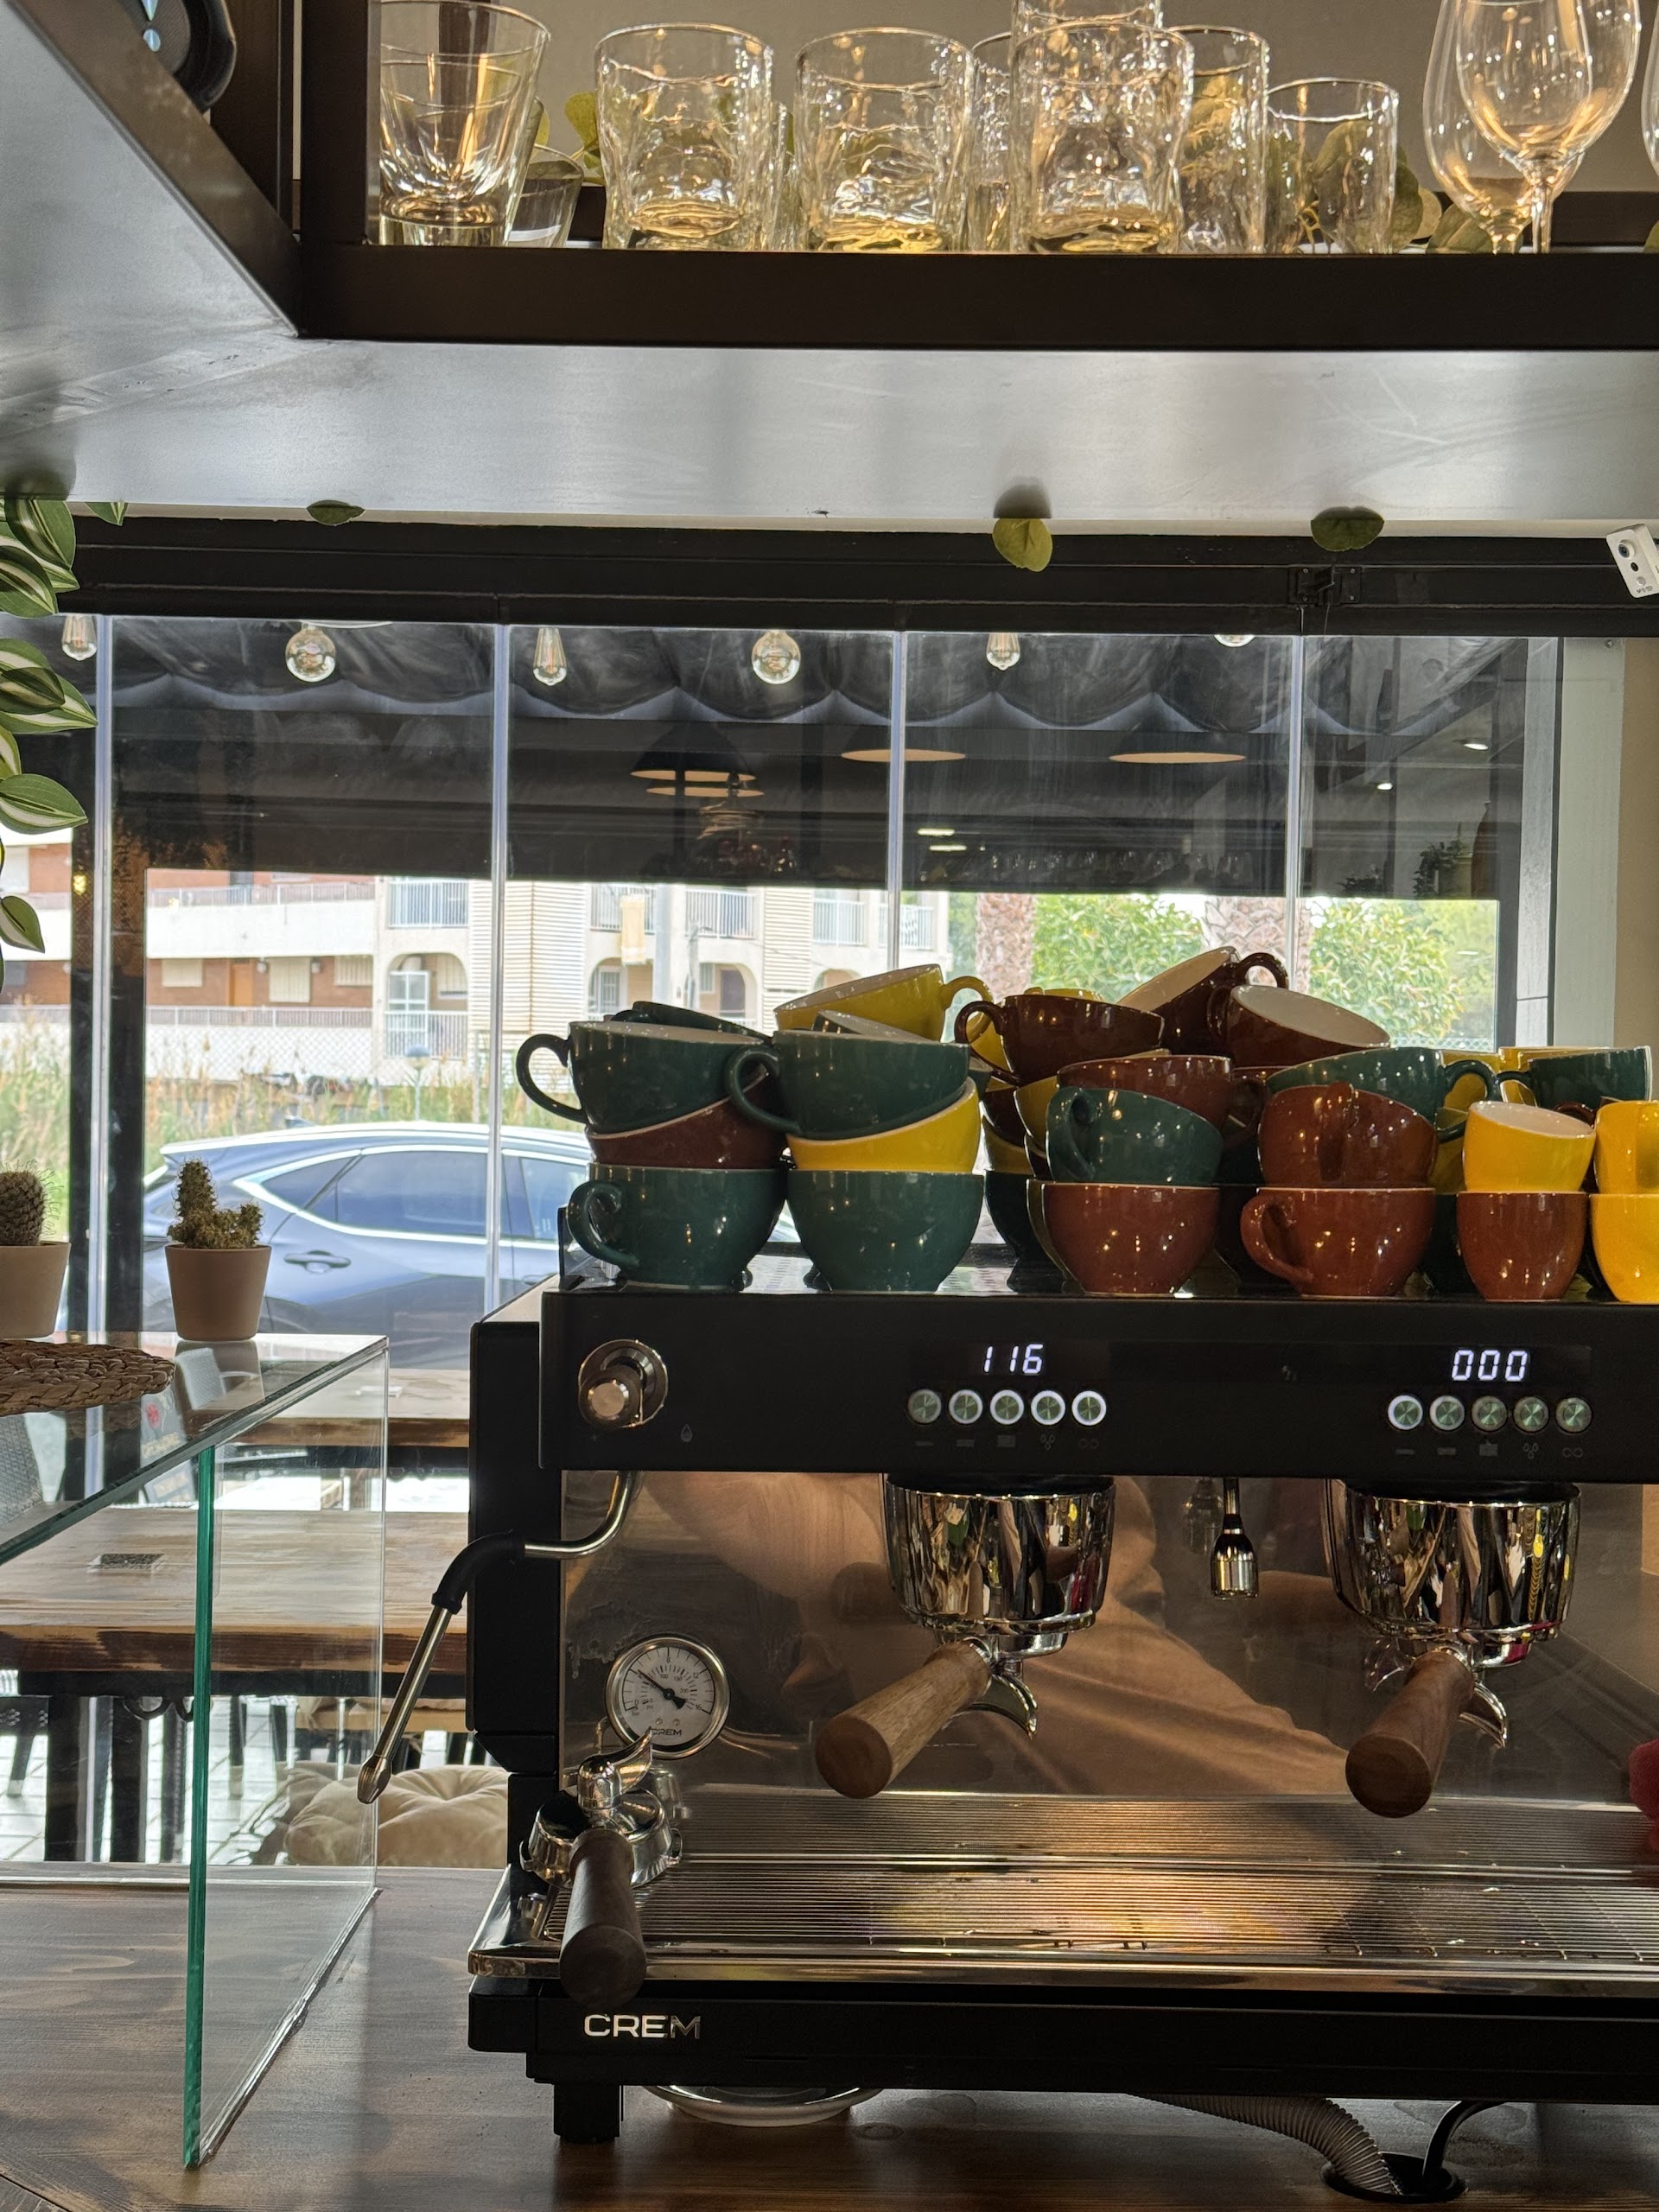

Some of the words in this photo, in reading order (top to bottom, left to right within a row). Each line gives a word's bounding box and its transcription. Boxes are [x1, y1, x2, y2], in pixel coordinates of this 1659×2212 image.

[983, 1343, 1044, 1376] 116
[1451, 1350, 1529, 1382] 000
[584, 2014, 702, 2039] CREM
